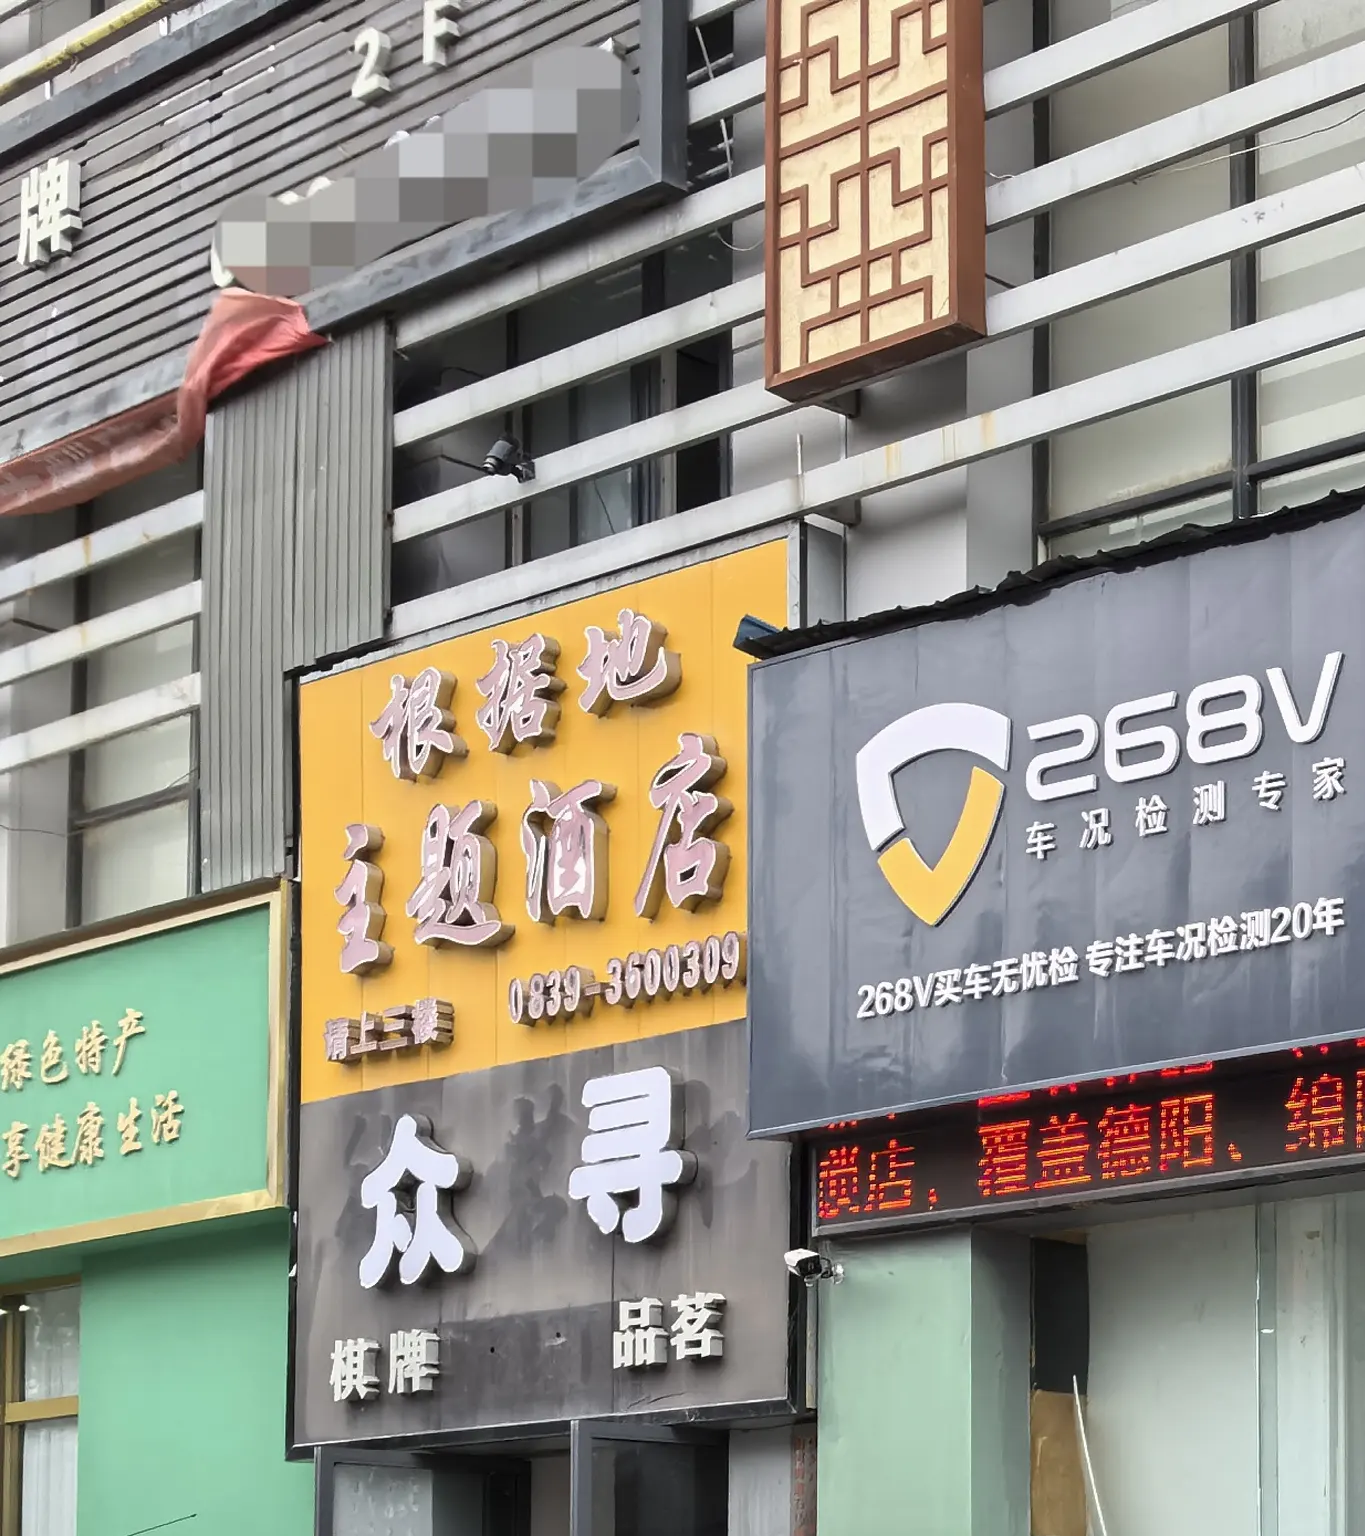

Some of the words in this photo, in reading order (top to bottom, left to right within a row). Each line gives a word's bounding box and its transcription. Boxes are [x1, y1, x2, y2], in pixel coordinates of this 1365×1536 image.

[17, 156, 83, 271] 牌
[369, 607, 684, 782] 根据地
[1025, 651, 1345, 803] 268V
[334, 733, 735, 976] 主题酒店
[1025, 757, 1347, 862] 车况检测专家
[508, 930, 745, 1028] 0839-3600309
[857, 945, 1081, 1020] 268V买车无忧检
[1085, 896, 1346, 978] 专注车况检测20年
[359, 1065, 700, 1293] 众寻
[330, 1328, 442, 1403] 棋牌
[613, 1291, 727, 1370] 品茗
